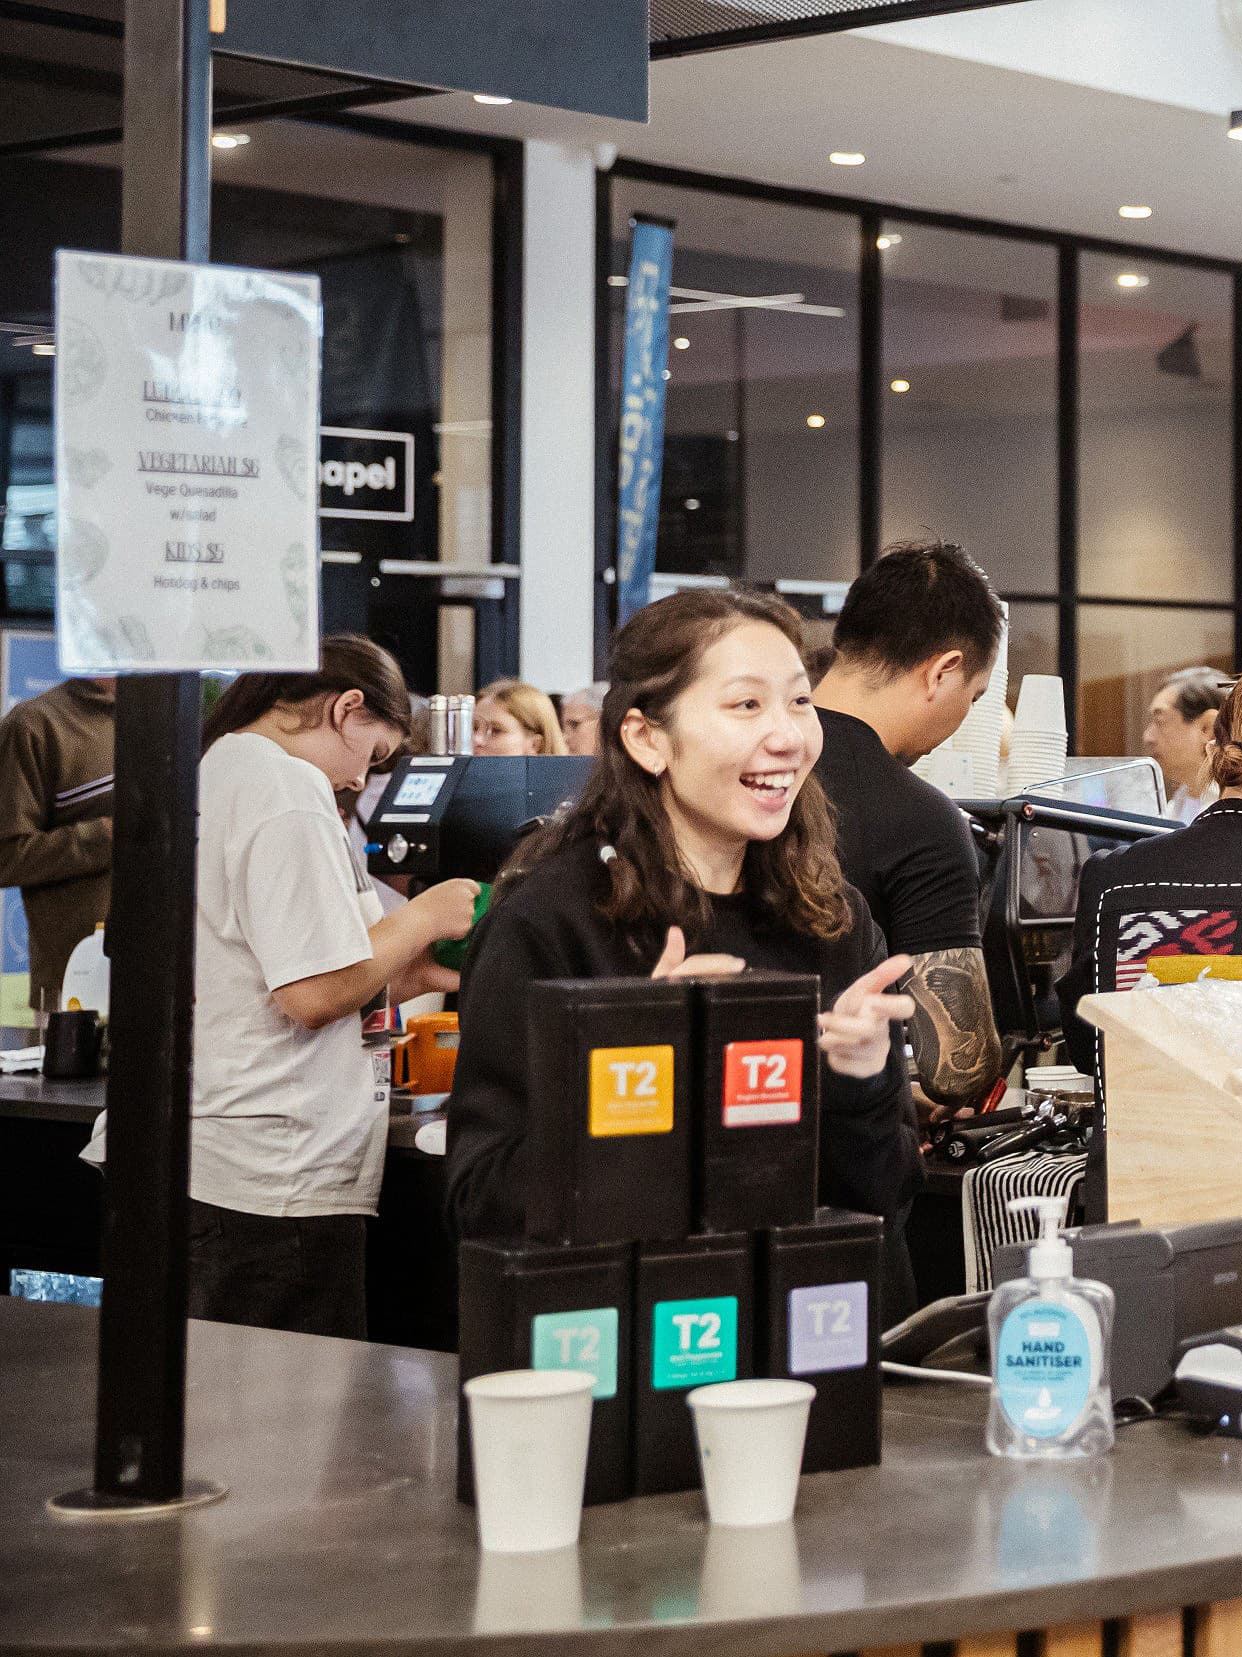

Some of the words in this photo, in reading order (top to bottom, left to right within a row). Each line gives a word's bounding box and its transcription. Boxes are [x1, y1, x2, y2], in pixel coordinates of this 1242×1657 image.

[145, 481, 177, 499] Vege
[200, 576, 208, 589] &
[210, 577, 240, 592] chips
[608, 1061, 657, 1097] T2
[741, 1052, 787, 1089] T2
[671, 1311, 721, 1350] T2
[807, 1300, 850, 1336] T2
[551, 1325, 600, 1364] T2
[1005, 1354, 1082, 1368] SANITISER
[1021, 1341, 1066, 1353] HAND
